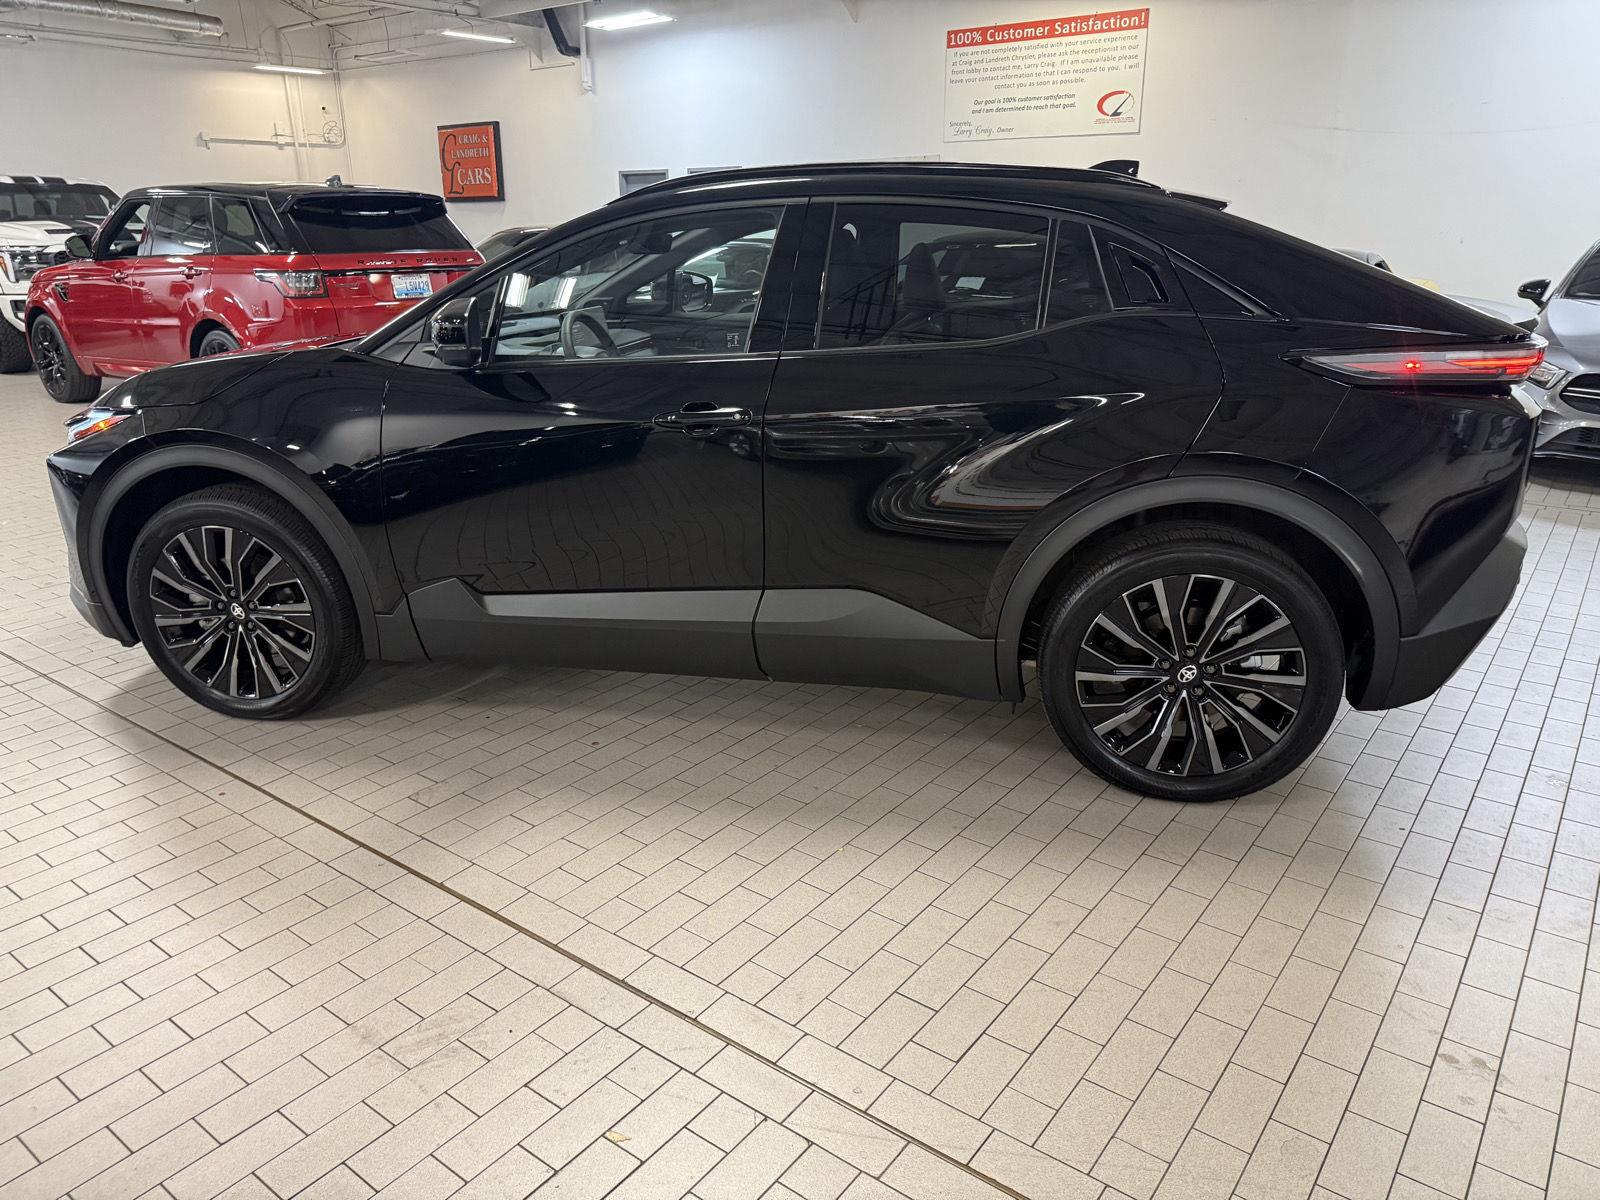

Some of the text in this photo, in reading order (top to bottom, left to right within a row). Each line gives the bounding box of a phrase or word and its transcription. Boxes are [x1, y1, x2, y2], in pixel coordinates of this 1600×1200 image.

[950, 12, 1145, 45] 100% Customer Satisfaction!
[458, 134, 488, 144] CRAIG &
[451, 148, 488, 158] LANDRETH
[458, 168, 492, 185] CARS
